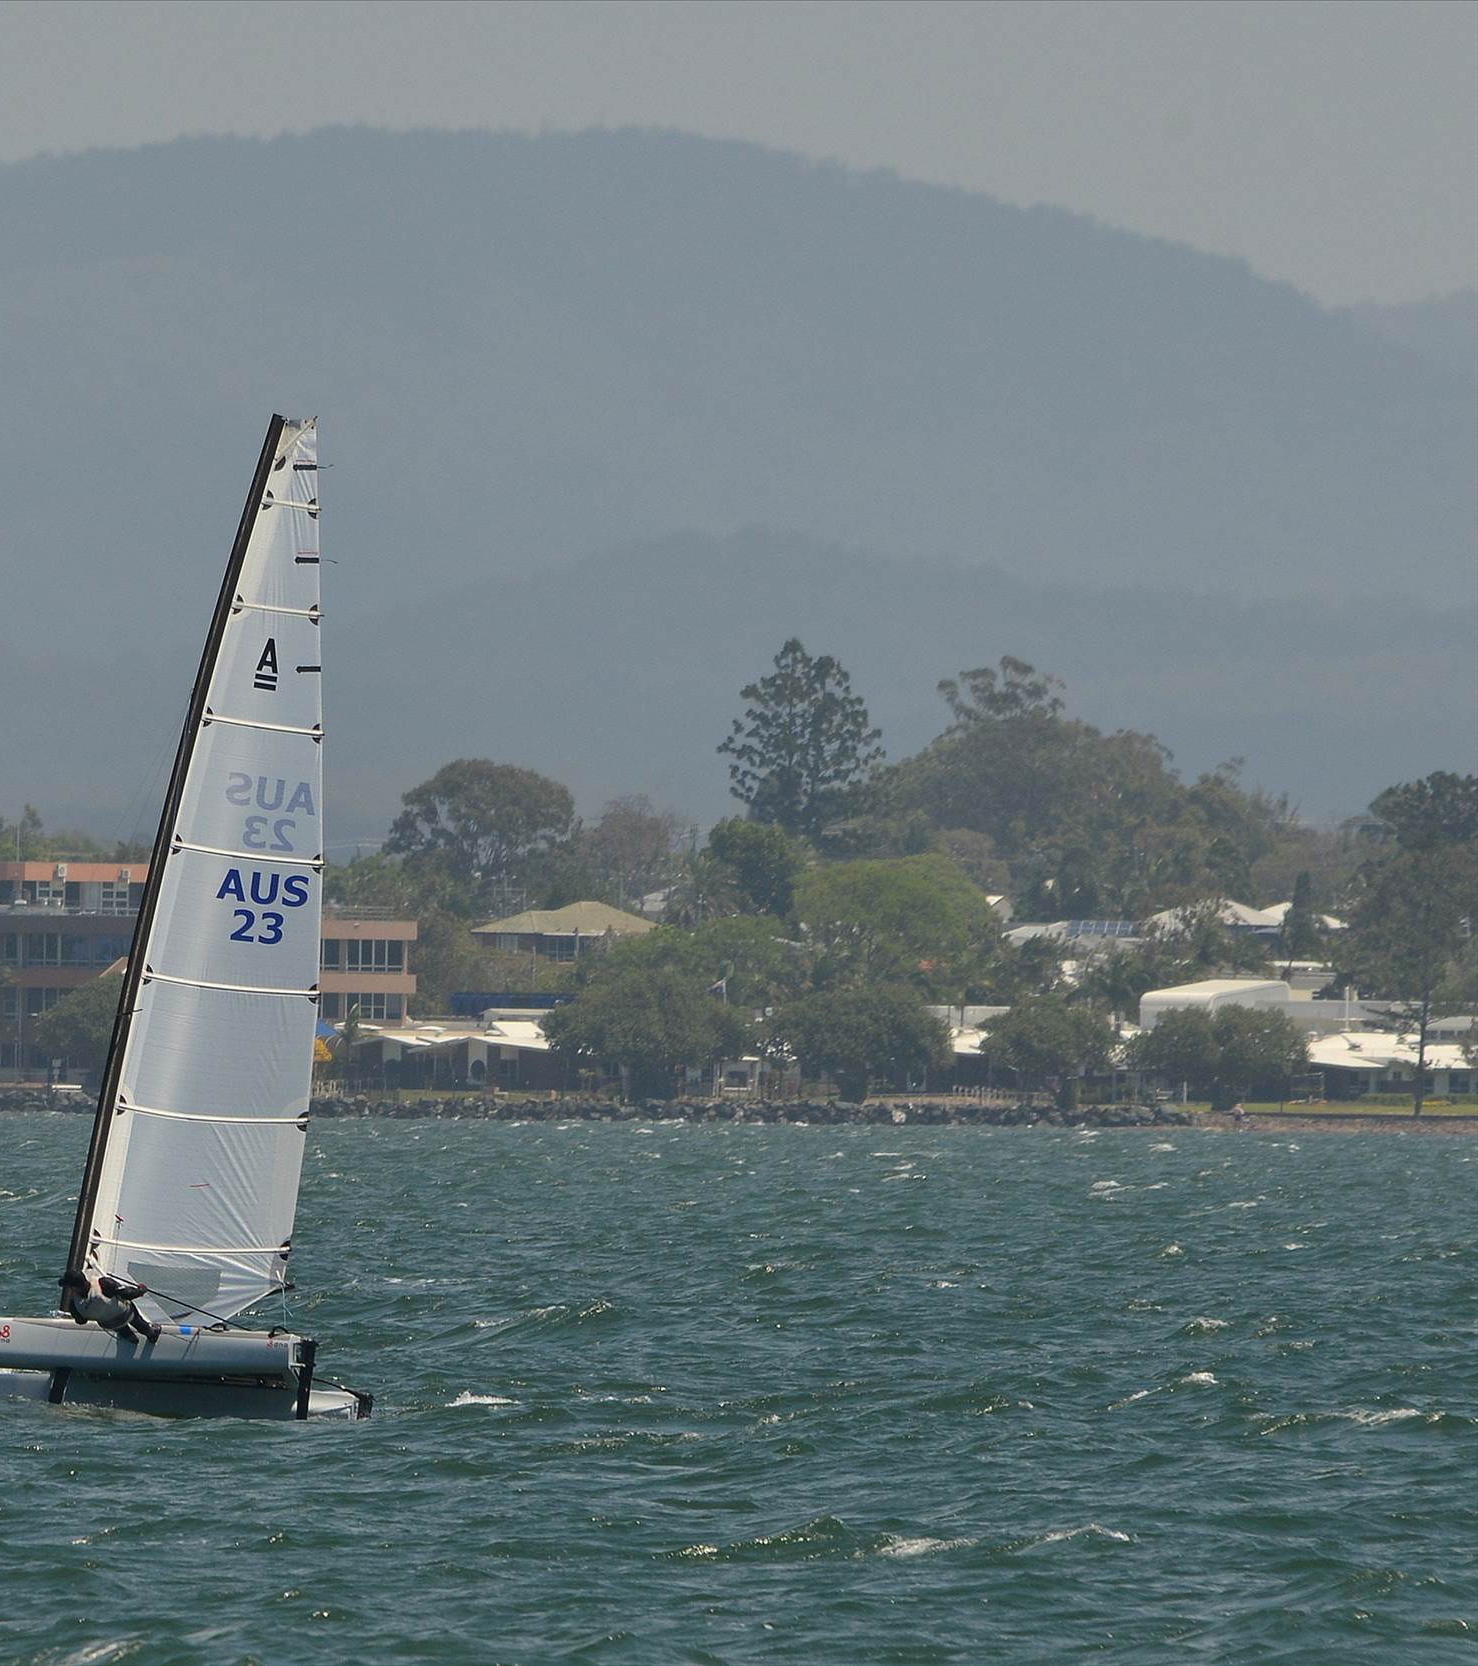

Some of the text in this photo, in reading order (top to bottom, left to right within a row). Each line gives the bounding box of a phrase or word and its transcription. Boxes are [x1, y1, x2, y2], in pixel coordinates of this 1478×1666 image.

[256, 637, 278, 674] A
[215, 868, 310, 908] AUS
[230, 909, 284, 945] 23
